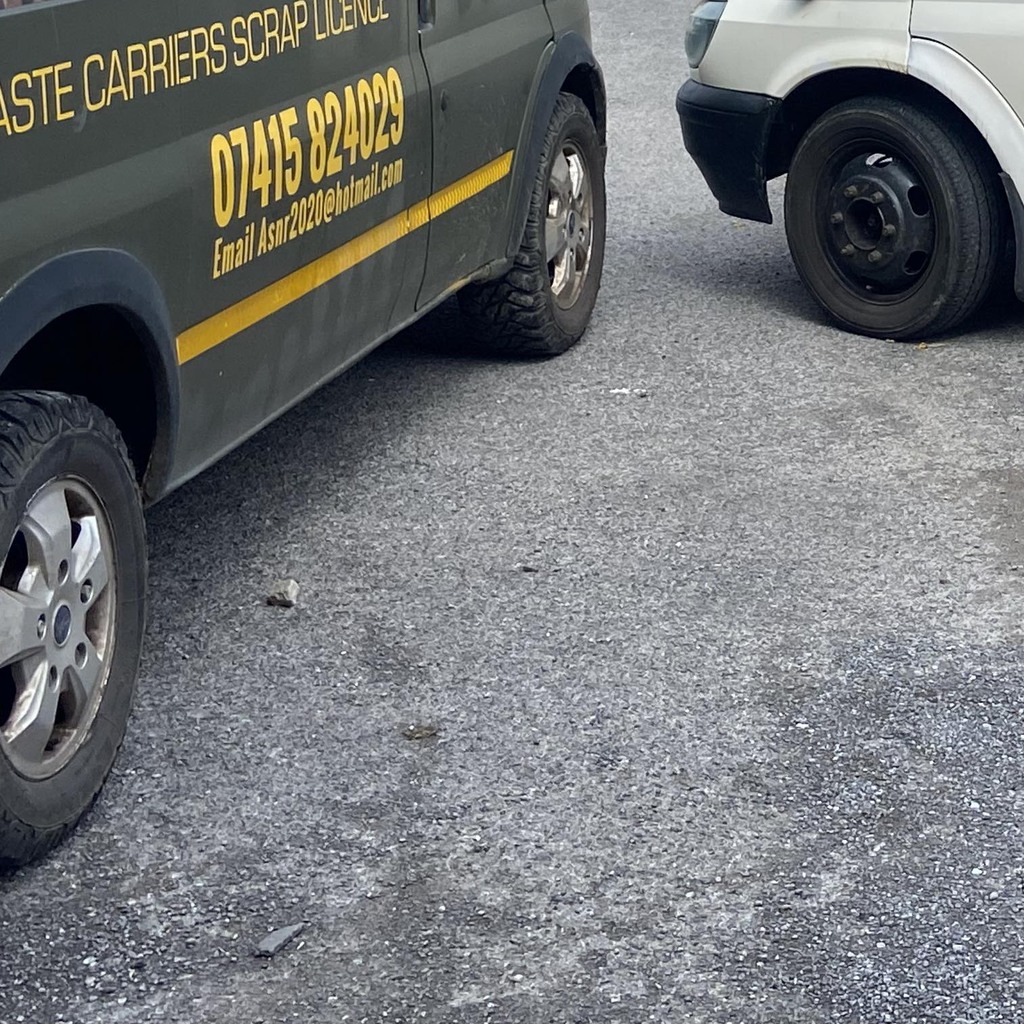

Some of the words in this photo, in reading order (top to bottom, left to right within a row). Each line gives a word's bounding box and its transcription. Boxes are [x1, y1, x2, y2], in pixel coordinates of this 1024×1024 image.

[83, 21, 228, 112] CARRIERS
[233, 0, 309, 68] SCRAP
[210, 107, 303, 229] 07415
[306, 67, 405, 185] 824029
[213, 222, 255, 280] Email
[257, 158, 403, 257] Asnr2020@hotmail.com
